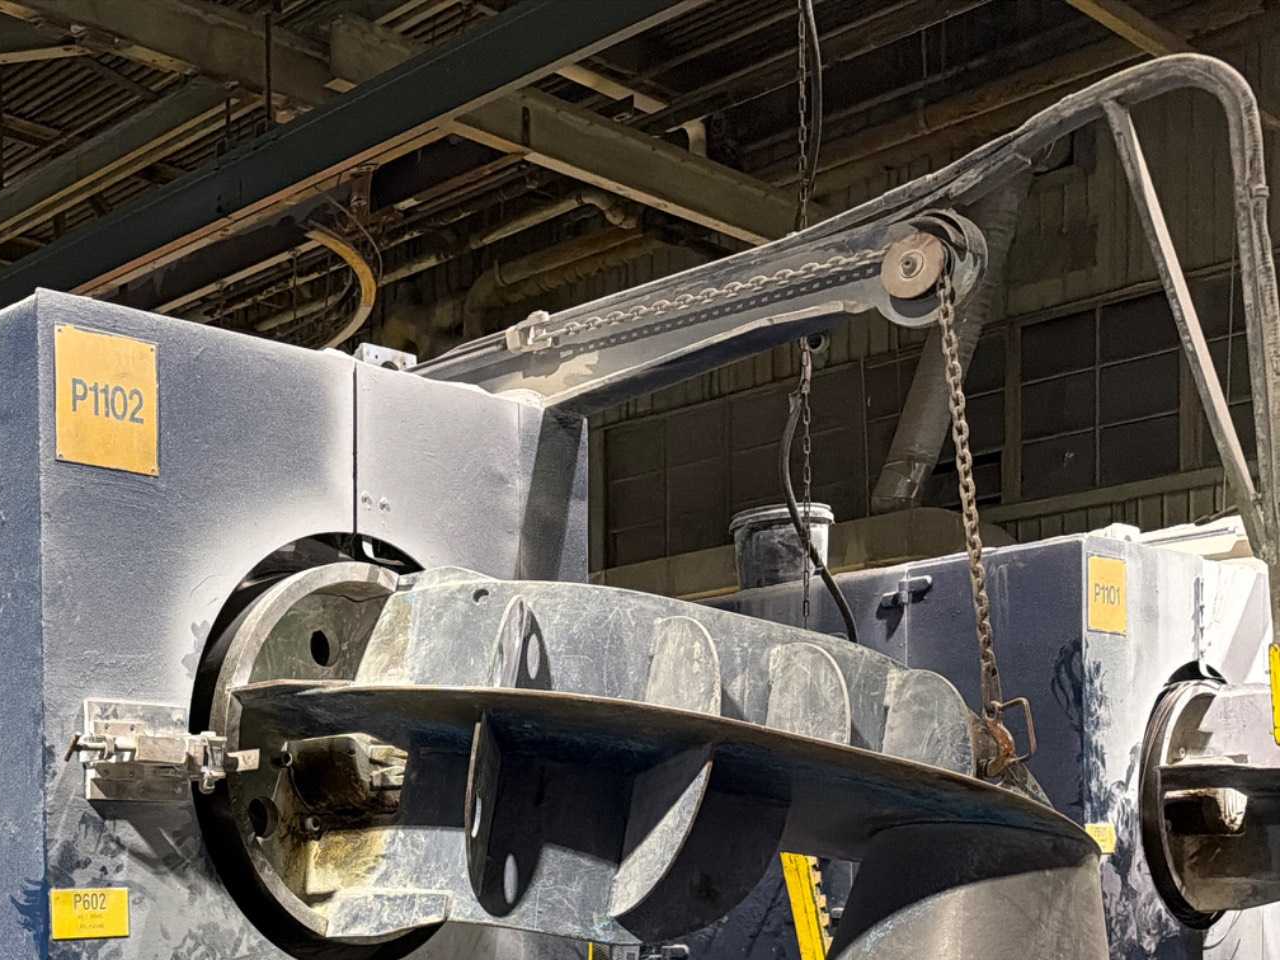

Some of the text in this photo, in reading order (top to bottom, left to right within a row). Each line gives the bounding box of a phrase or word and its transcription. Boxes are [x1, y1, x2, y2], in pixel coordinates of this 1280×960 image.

[71, 377, 144, 425] P1102
[1094, 583, 1121, 605] P1101
[73, 892, 106, 910] P602
